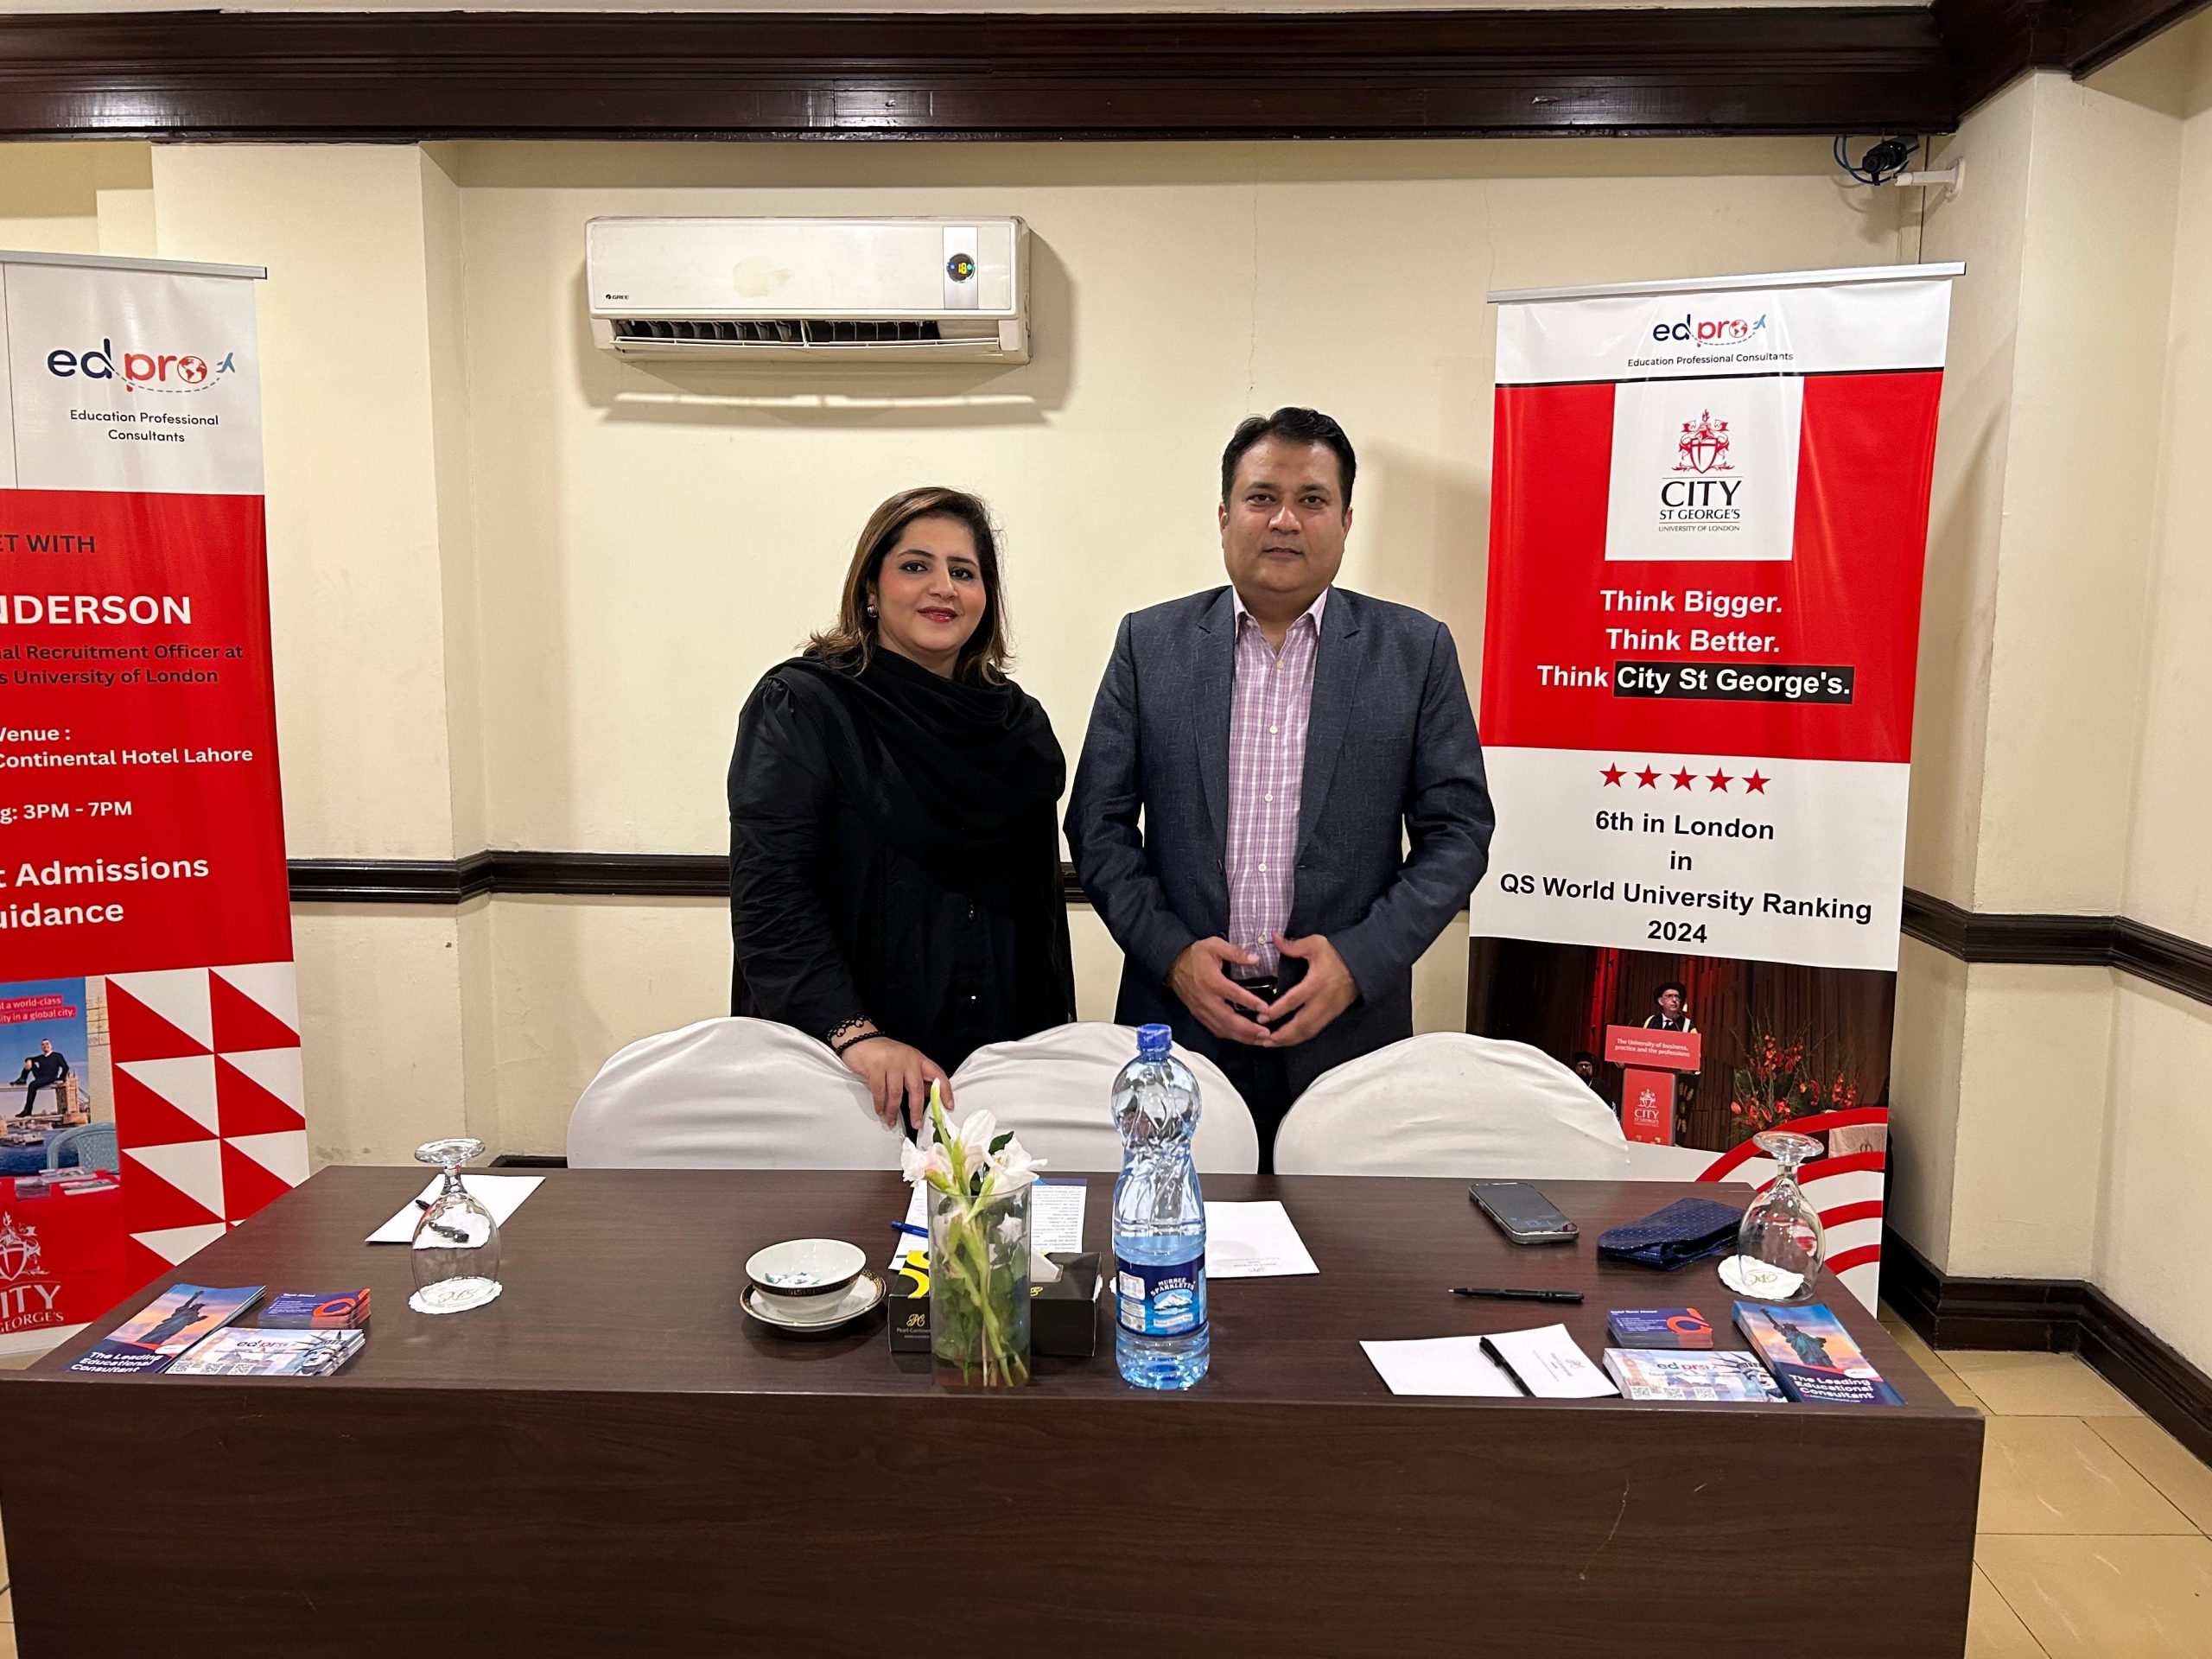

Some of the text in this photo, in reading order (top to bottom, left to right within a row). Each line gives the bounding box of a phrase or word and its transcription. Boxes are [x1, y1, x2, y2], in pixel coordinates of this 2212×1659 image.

[1628, 352, 1794, 367] Education Professional Consultants
[70, 410, 219, 426] Education Professional
[108, 429, 185, 442] Consultants
[1661, 480, 1742, 507] CITY
[1659, 509, 1740, 520] ST GEORGE'S
[26, 535, 95, 553] WITH
[1601, 590, 1783, 617] Think Bigger.
[1605, 629, 1779, 653] Think Better.
[27, 645, 149, 659] Recruitment
[154, 645, 220, 658] Officer
[225, 646, 244, 658] at
[14, 670, 115, 687] University
[121, 669, 141, 683] of
[146, 669, 218, 683] London
[1537, 665, 1850, 698] Think City St George's.
[122, 748, 179, 765] Hotel
[184, 747, 253, 763] Lahore
[23, 803, 70, 820] 3PM
[87, 801, 132, 817] 7PM
[1596, 810, 1774, 840] 6th in London
[1669, 851, 1693, 870] in
[15, 855, 210, 887] Admissions
[1500, 874, 1872, 924] QS World University Ranking
[1647, 919, 1707, 943] 2024
[13, 997, 61, 1008] world-class
[30, 1009, 56, 1020] global
[58, 1008, 75, 1017] city.
[1628, 1039, 1655, 1048] University
[1634, 1109, 1659, 1119] CITY
[79, 1357, 155, 1366] Educational
[113, 1353, 163, 1363] Leading
[71, 1363, 140, 1372] Consultant
[1789, 1374, 1872, 1386] The Leading
[1794, 1381, 1874, 1392] Educational
[1799, 1387, 1874, 1399] Consultant
